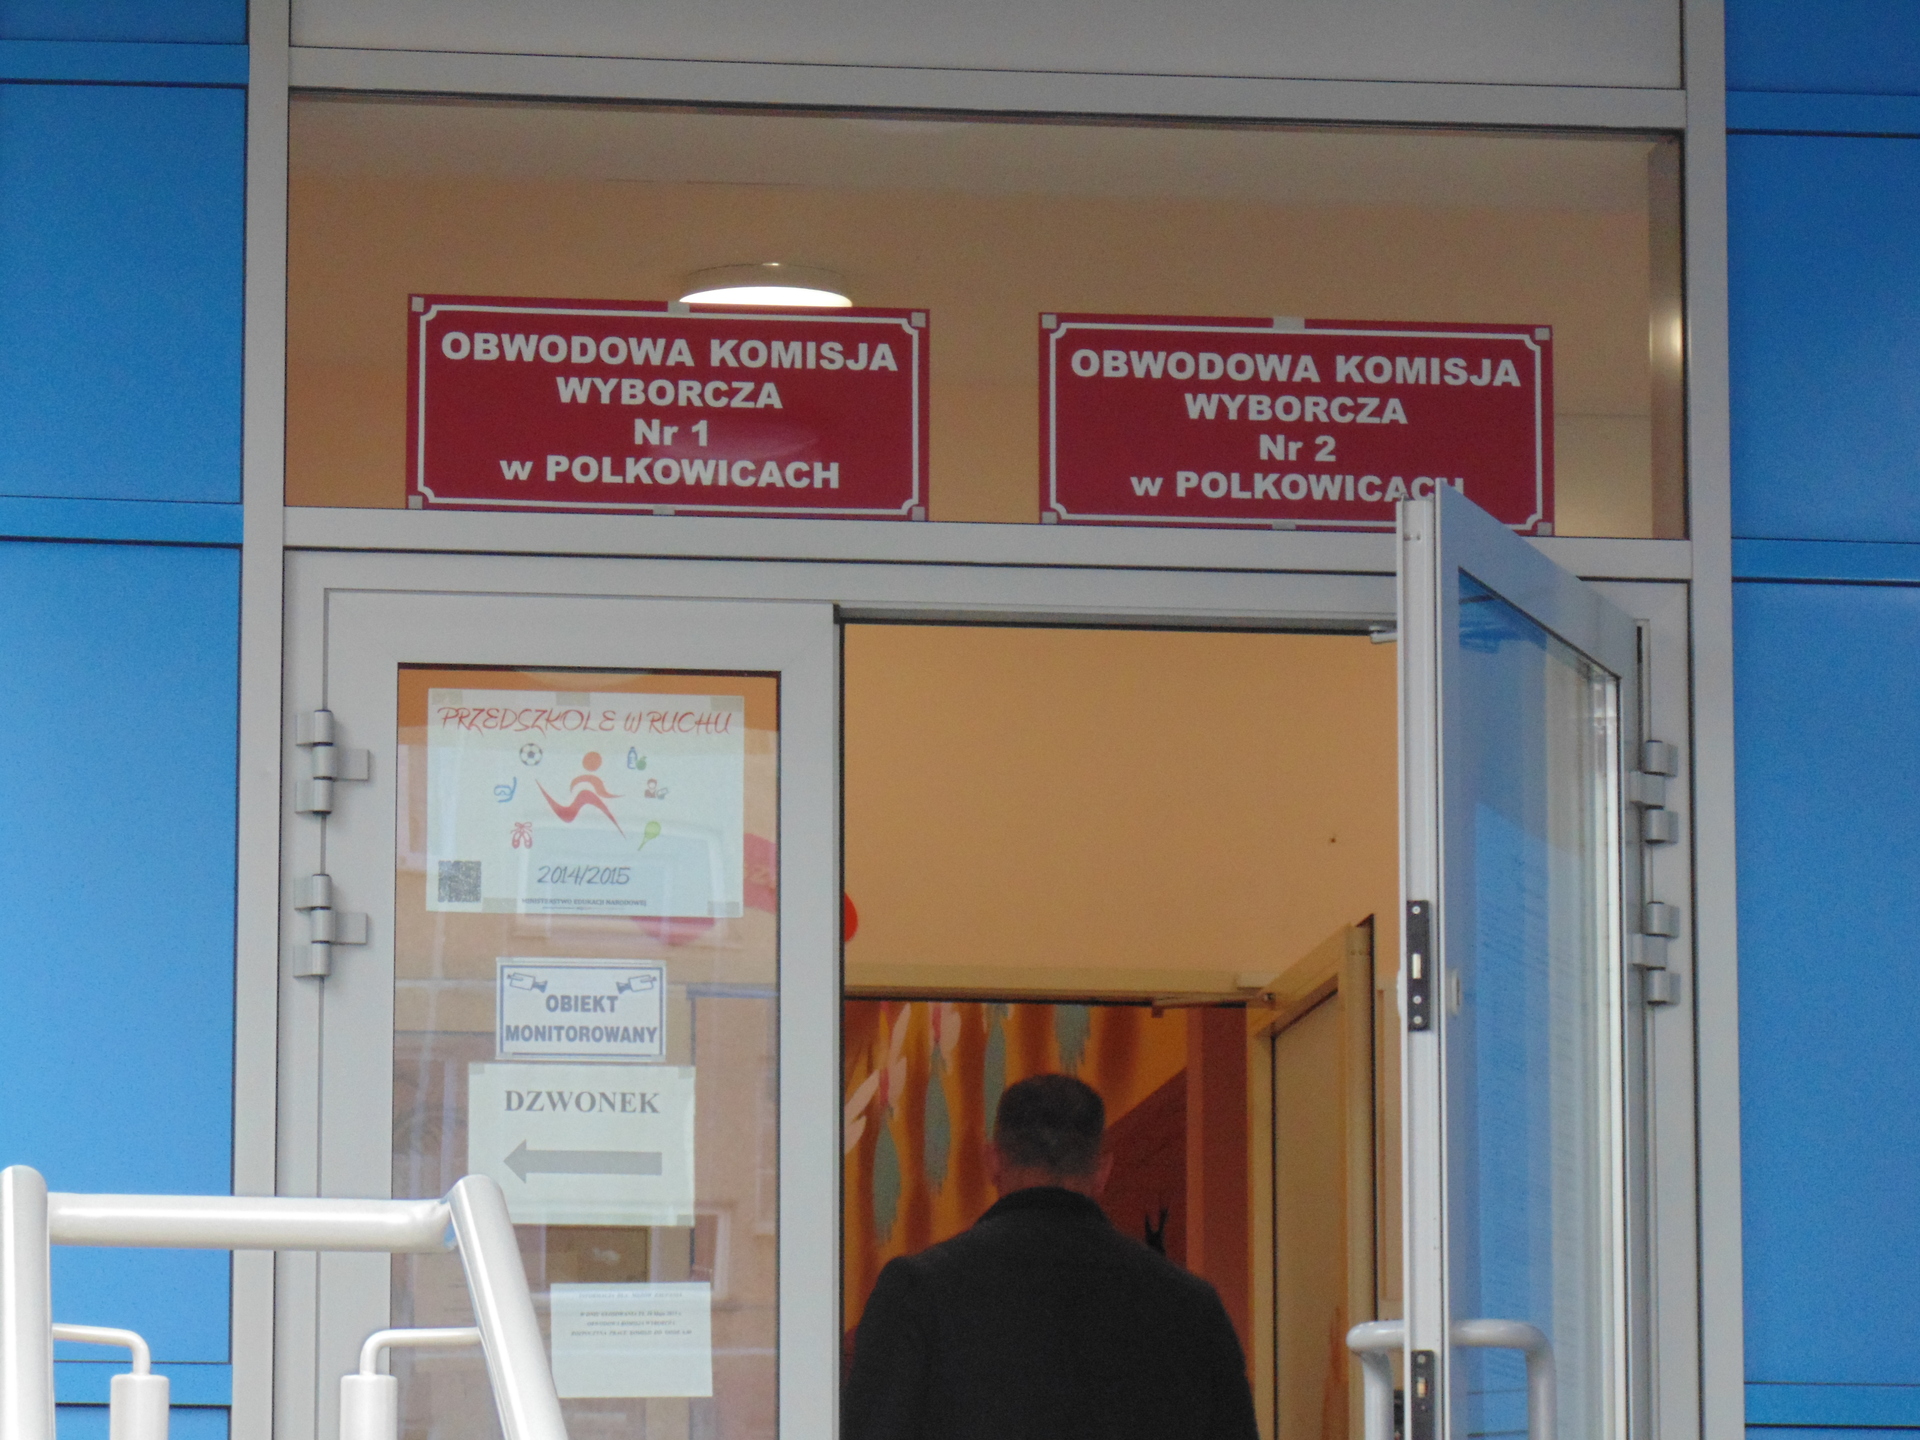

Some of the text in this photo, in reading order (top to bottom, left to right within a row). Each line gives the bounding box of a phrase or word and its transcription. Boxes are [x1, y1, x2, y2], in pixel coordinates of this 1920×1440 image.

[441, 331, 898, 371] OBWODOWA KOMISJA
[1071, 349, 1521, 387] OBWODOWA KOMISJA
[557, 377, 783, 409] WYBORCZA
[1185, 393, 1407, 424] WYBORCZA
[634, 419, 708, 446] Nr 1
[1259, 435, 1336, 462] Nr 2
[500, 455, 840, 489] w POLKOWICACH
[1130, 476, 1164, 496] w
[437, 707, 732, 738] PRZEDSZKOLE W RUCHU
[537, 865, 630, 886] 2014/2015
[546, 995, 618, 1013] OBIEKT
[505, 1025, 658, 1043] MONITOROWANY
[505, 1090, 660, 1113] DZWONEK
